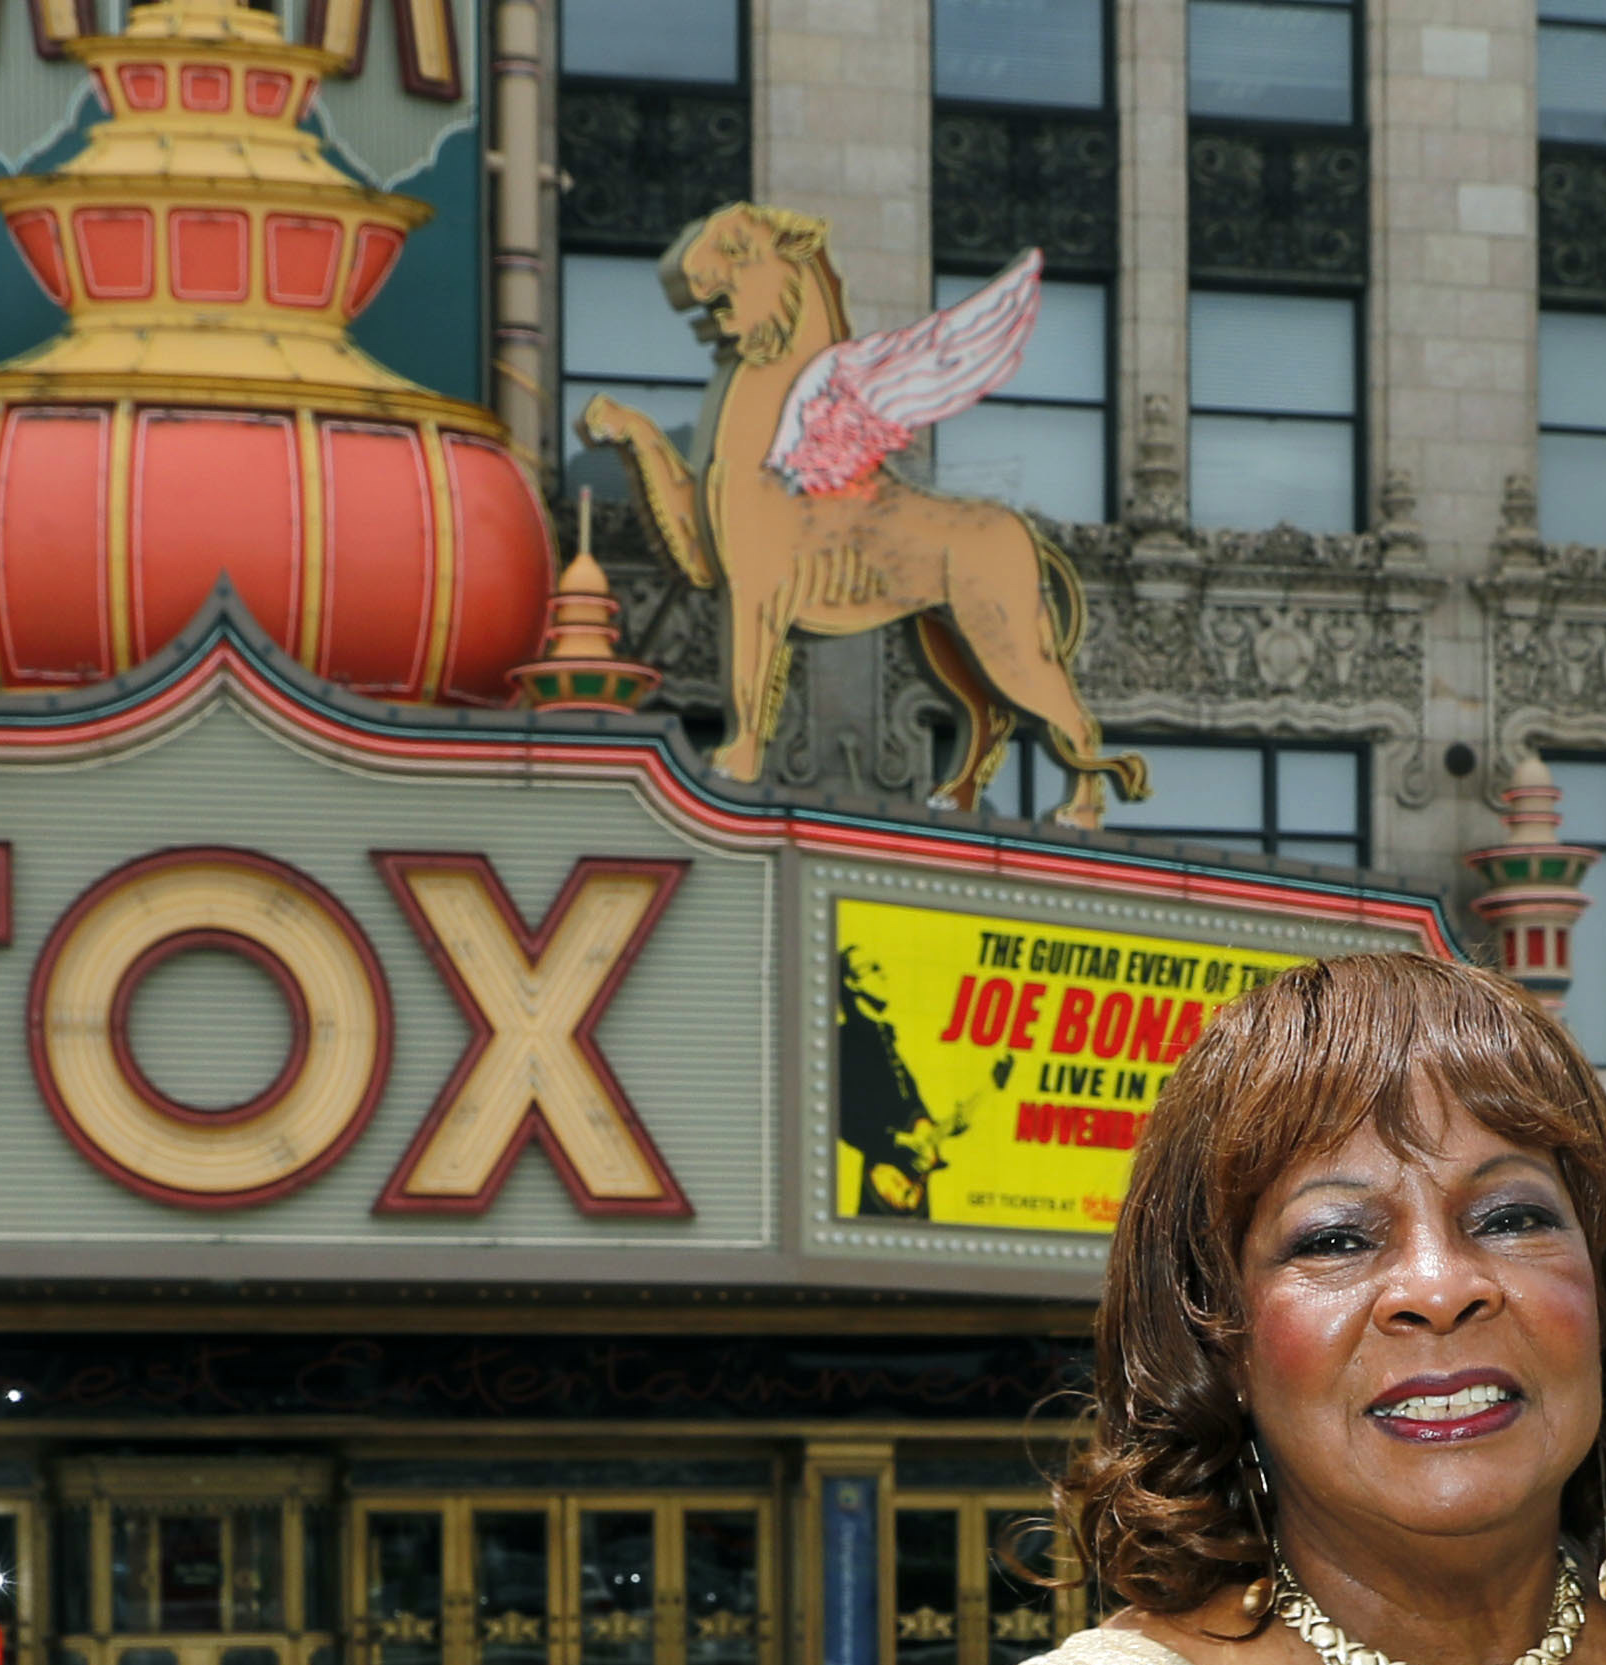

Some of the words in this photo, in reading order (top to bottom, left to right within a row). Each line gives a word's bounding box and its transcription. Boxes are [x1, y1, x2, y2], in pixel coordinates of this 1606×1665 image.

[979, 931, 1026, 970] THE
[1029, 937, 1120, 981] GUITAR
[1125, 950, 1200, 991] EVENT
[1202, 959, 1233, 994] OF
[939, 974, 1048, 1051] JOE
[1050, 986, 1223, 1064] BONA
[1038, 1062, 1106, 1098] LIVE
[1114, 1069, 1147, 1101] IN
[1015, 1101, 1151, 1151] NOVEMB
